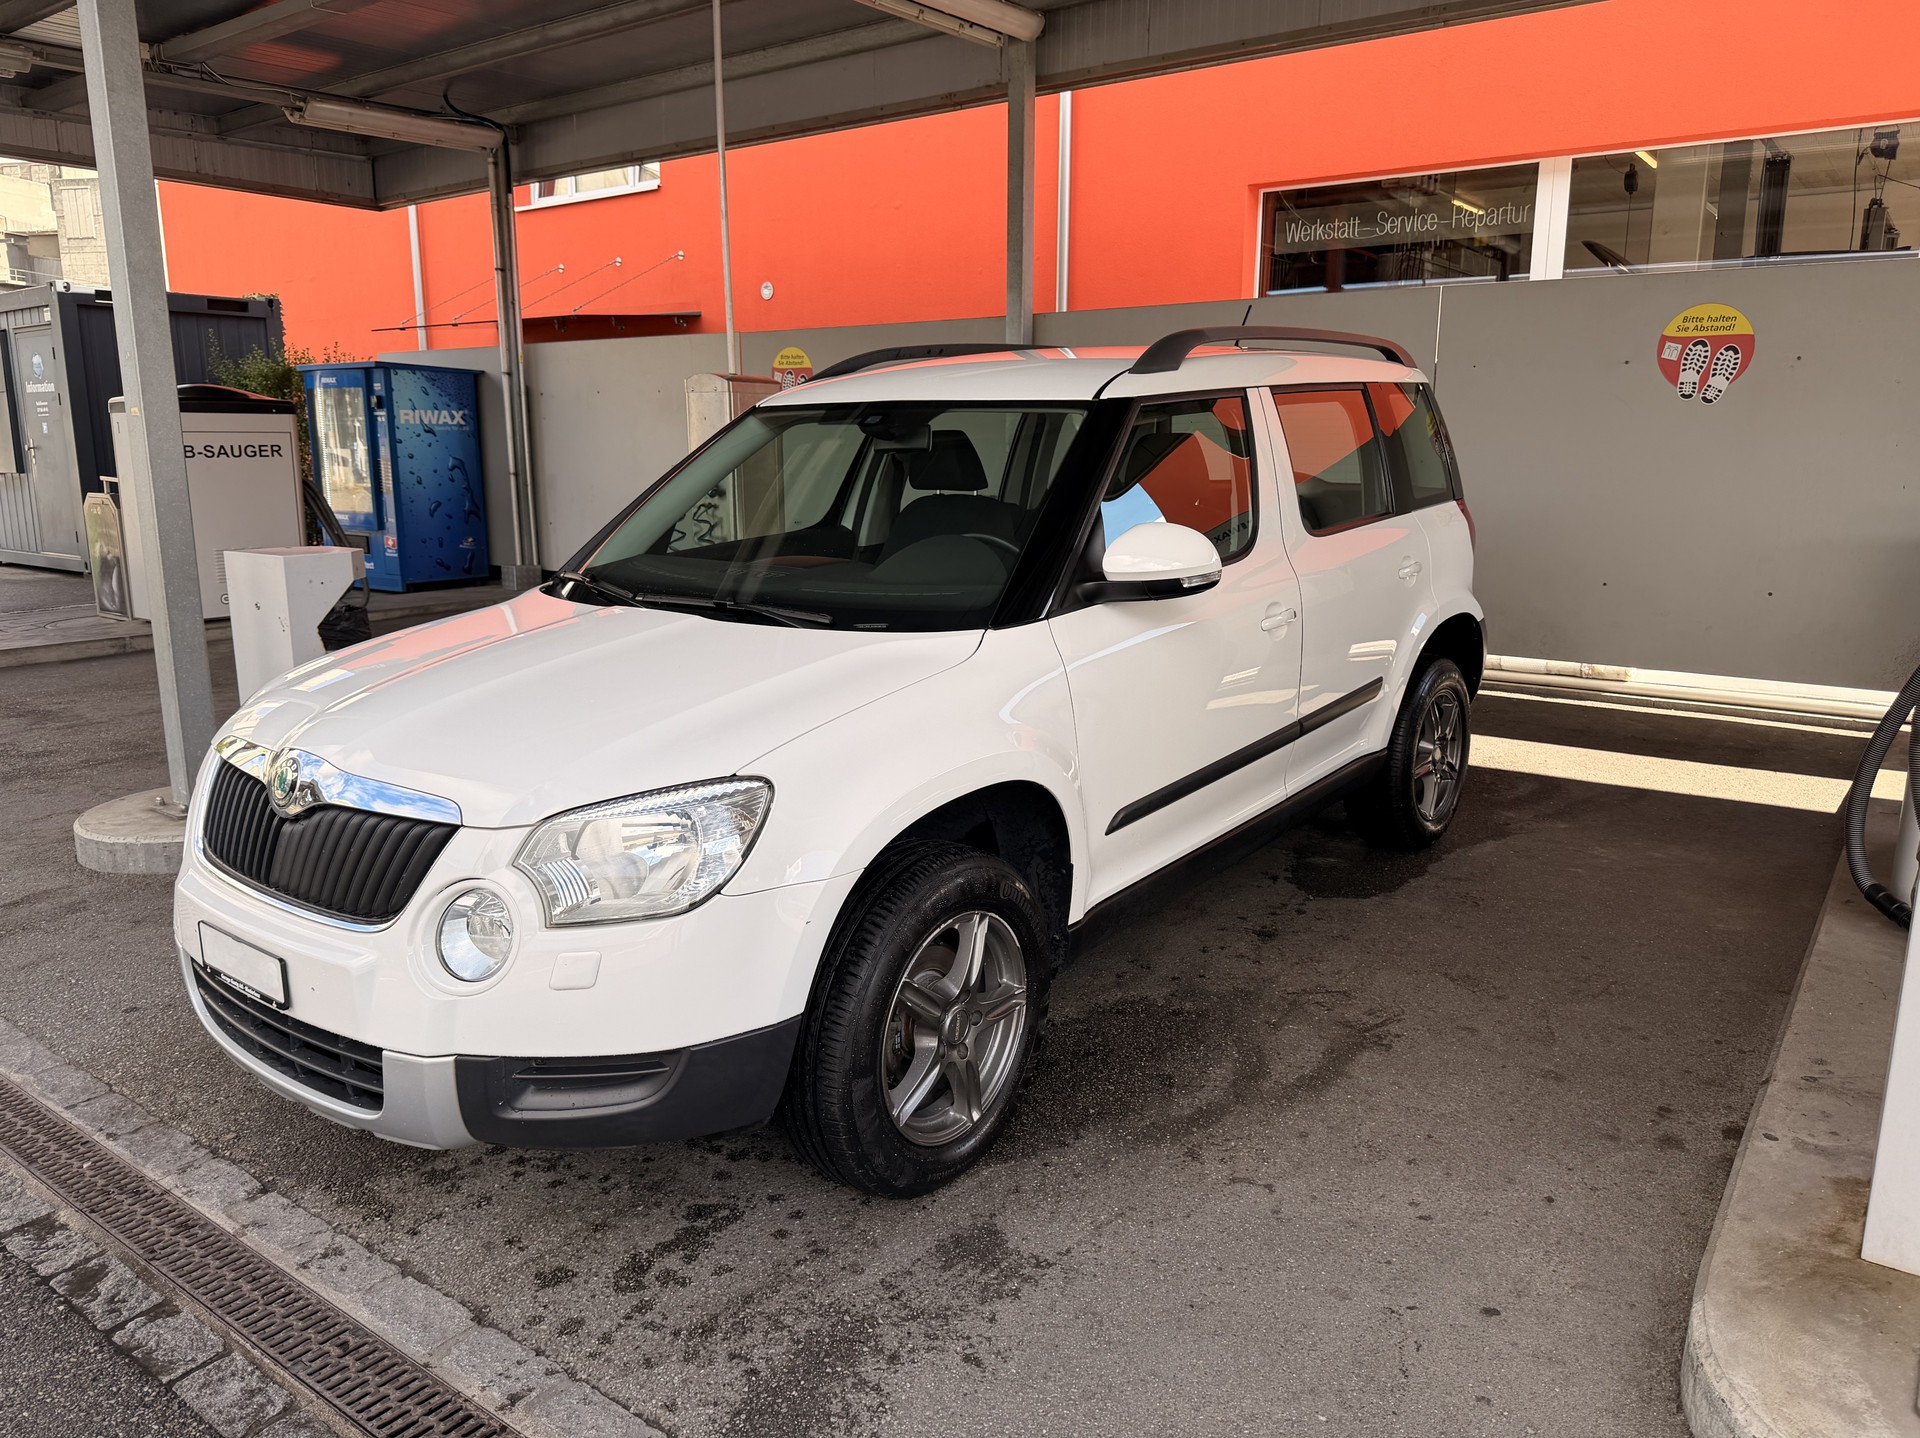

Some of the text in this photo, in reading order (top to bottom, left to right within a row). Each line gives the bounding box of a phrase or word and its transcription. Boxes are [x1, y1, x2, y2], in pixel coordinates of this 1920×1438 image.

[1285, 216, 1360, 243] Werkstatt
[1376, 208, 1438, 236] Service
[1452, 202, 1532, 232] Repartur
[1682, 314, 1737, 323] Bitte halten
[1675, 323, 1736, 333] Sie Abstand!
[25, 380, 56, 393] Information
[399, 409, 467, 425] RIWAX
[183, 444, 283, 459] B-SAUGER
